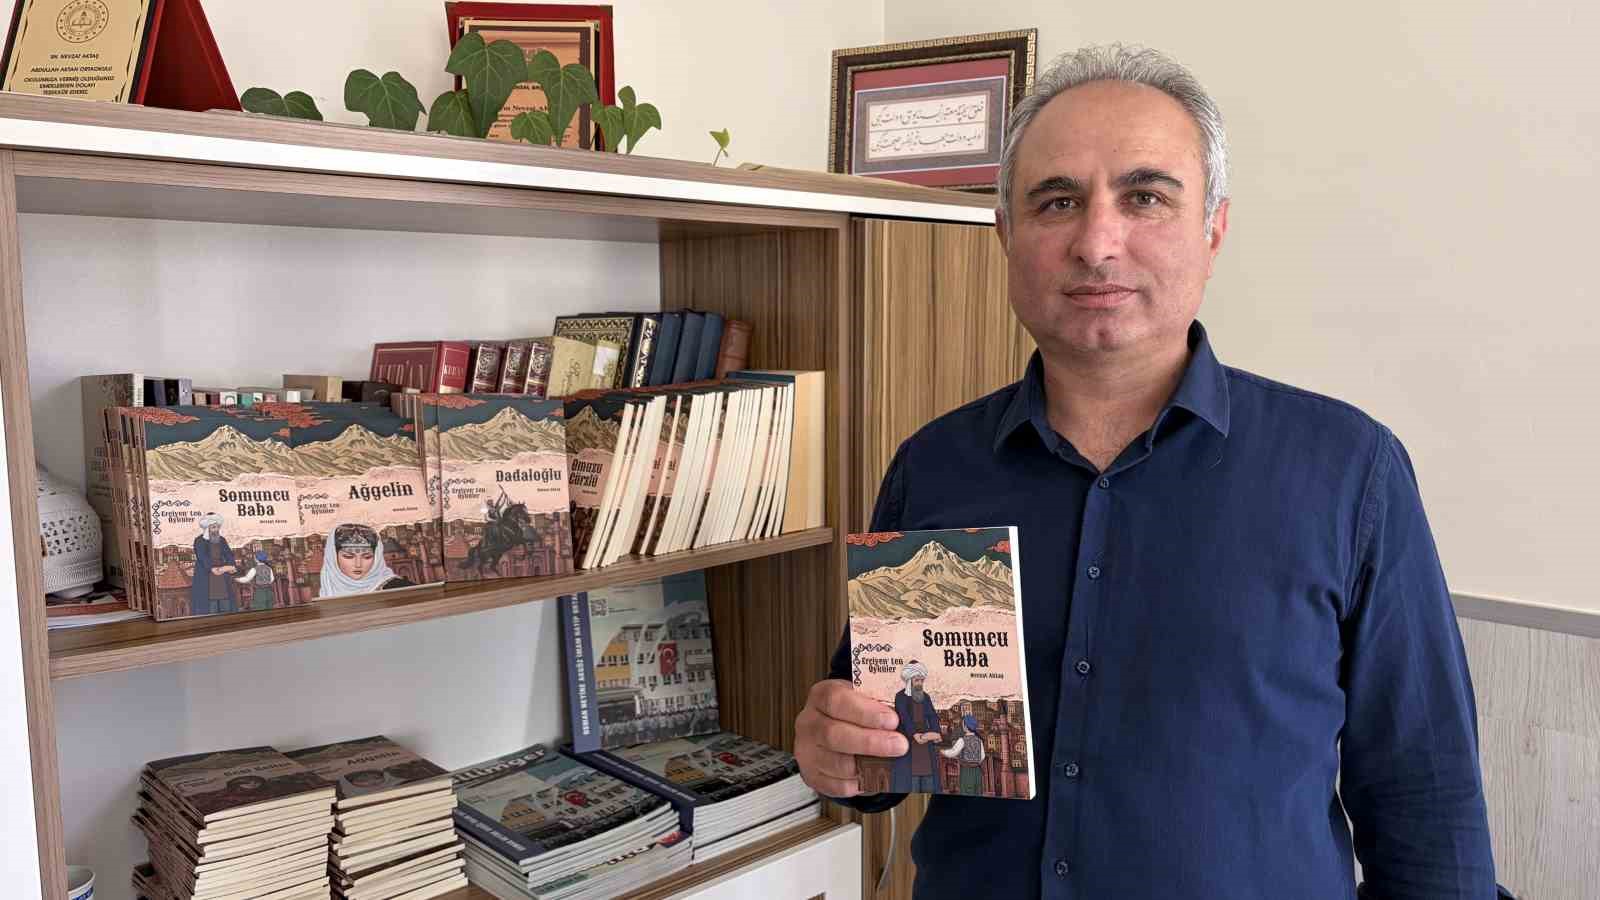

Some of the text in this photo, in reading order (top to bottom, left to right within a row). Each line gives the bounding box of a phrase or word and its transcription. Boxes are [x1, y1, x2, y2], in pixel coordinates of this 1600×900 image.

[495, 468, 562, 483] Dadaloğlu
[218, 488, 290, 503] Somuncu
[350, 481, 413, 502] Ağgelin
[237, 503, 275, 517] Baba
[922, 628, 1009, 648] Somuncu
[943, 649, 989, 668] Baba
